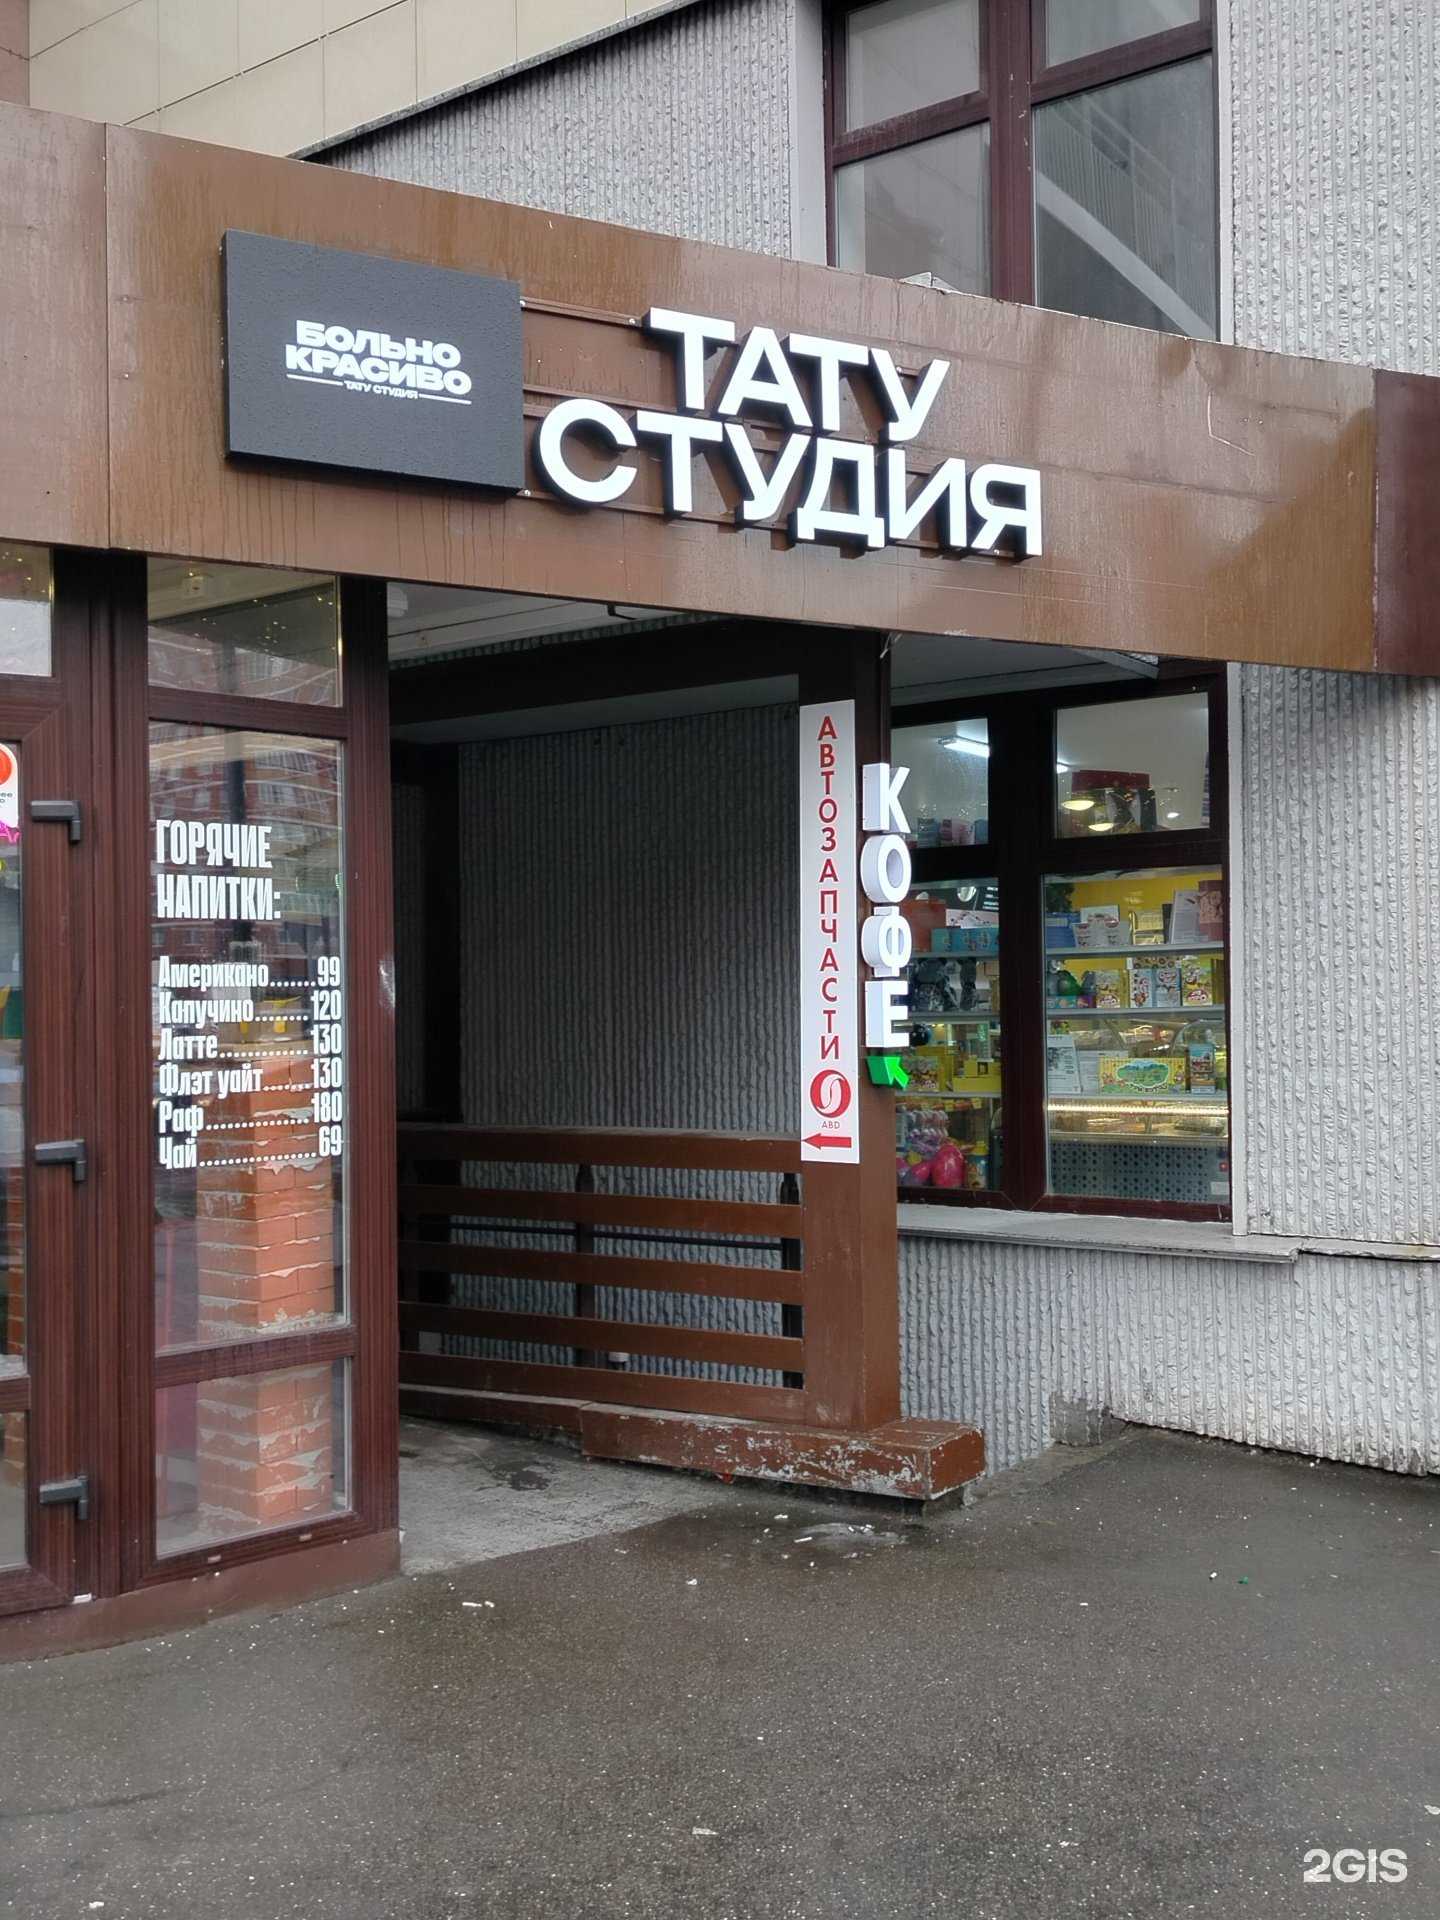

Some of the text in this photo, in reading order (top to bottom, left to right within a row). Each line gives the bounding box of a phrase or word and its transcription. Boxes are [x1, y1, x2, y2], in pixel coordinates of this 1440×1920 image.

[296, 319, 461, 369] БОЛЬНО
[285, 344, 472, 395] КРАСИВО
[649, 307, 951, 441] ТАТУ
[539, 399, 1042, 556] СТУДИЯ
[156, 819, 273, 868] ГОРЯЧИЕ
[156, 874, 281, 920] НАПИТКИ:
[817, 715, 840, 1060] АВТОЗАПЧАСТИ
[861, 762, 912, 1048] КОФЕ
[311, 990, 342, 1021] 120
[311, 1023, 342, 1054] 130
[158, 1062, 213, 1096] Флэт
[311, 1057, 342, 1088] 130
[311, 1091, 342, 1123] 180
[821, 1120, 840, 1129] ABD
